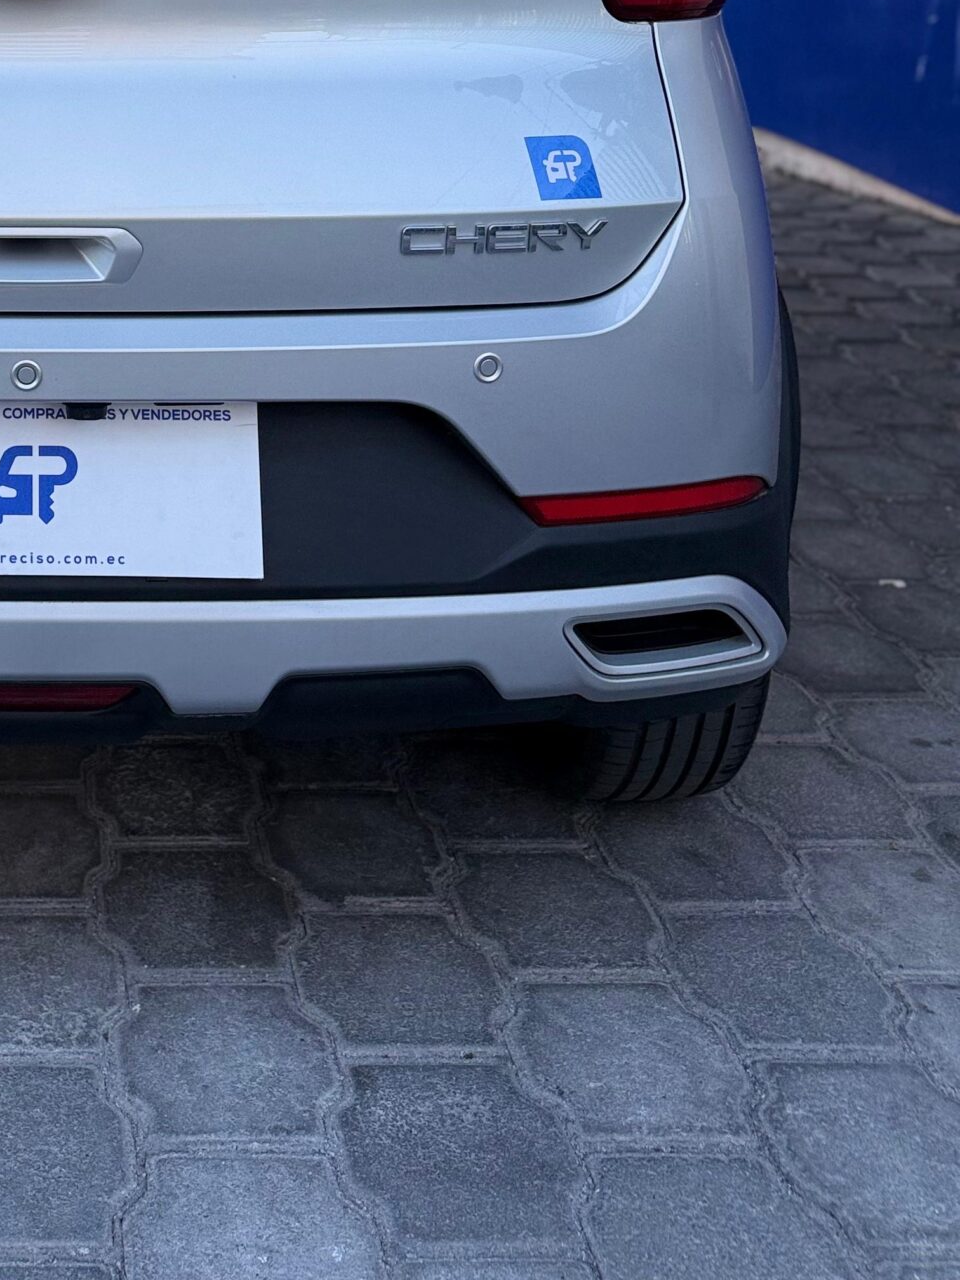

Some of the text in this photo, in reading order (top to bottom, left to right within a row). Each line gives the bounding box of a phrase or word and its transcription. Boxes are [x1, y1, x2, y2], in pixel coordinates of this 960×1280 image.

[400, 218, 608, 255] CHERY
[2, 407, 116, 420] COMPRAS
[119, 408, 130, 420] Y
[130, 408, 232, 422] VENDEDORES
